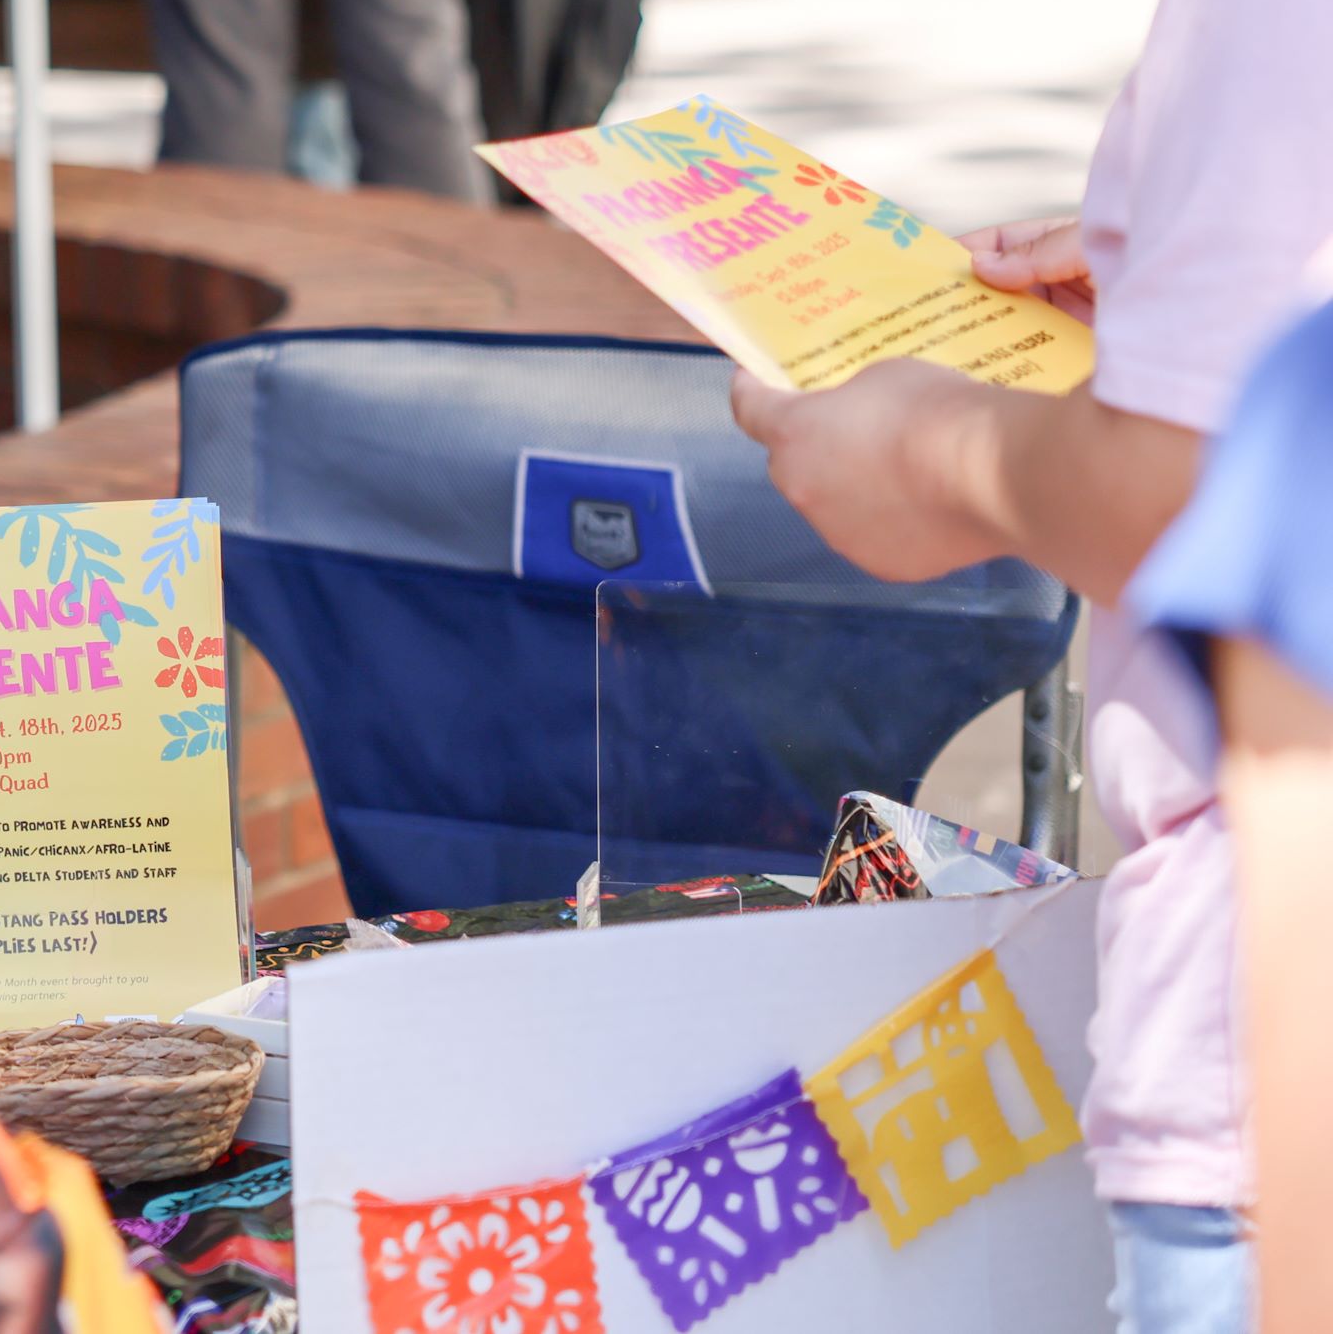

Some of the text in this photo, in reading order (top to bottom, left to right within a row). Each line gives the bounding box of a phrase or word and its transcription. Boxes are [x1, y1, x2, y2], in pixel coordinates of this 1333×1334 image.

[19, 718, 65, 736] 18th,
[71, 712, 122, 733] 2025
[0, 772, 49, 794] Quad
[14, 820, 67, 832] PROMOTE
[71, 817, 142, 830] AWARENESS
[146, 817, 170, 828] AND
[14, 871, 50, 883] DELTA
[55, 869, 111, 881] STUDENTS
[116, 868, 139, 880] AND
[144, 867, 177, 879] STAFF
[50, 910, 89, 927] PASS
[95, 908, 168, 925] HOLDERS
[5, 978, 37, 988] Month
[40, 978, 69, 987] event
[72, 975, 113, 988] brought
[117, 975, 128, 984] to
[130, 975, 149, 985] you
